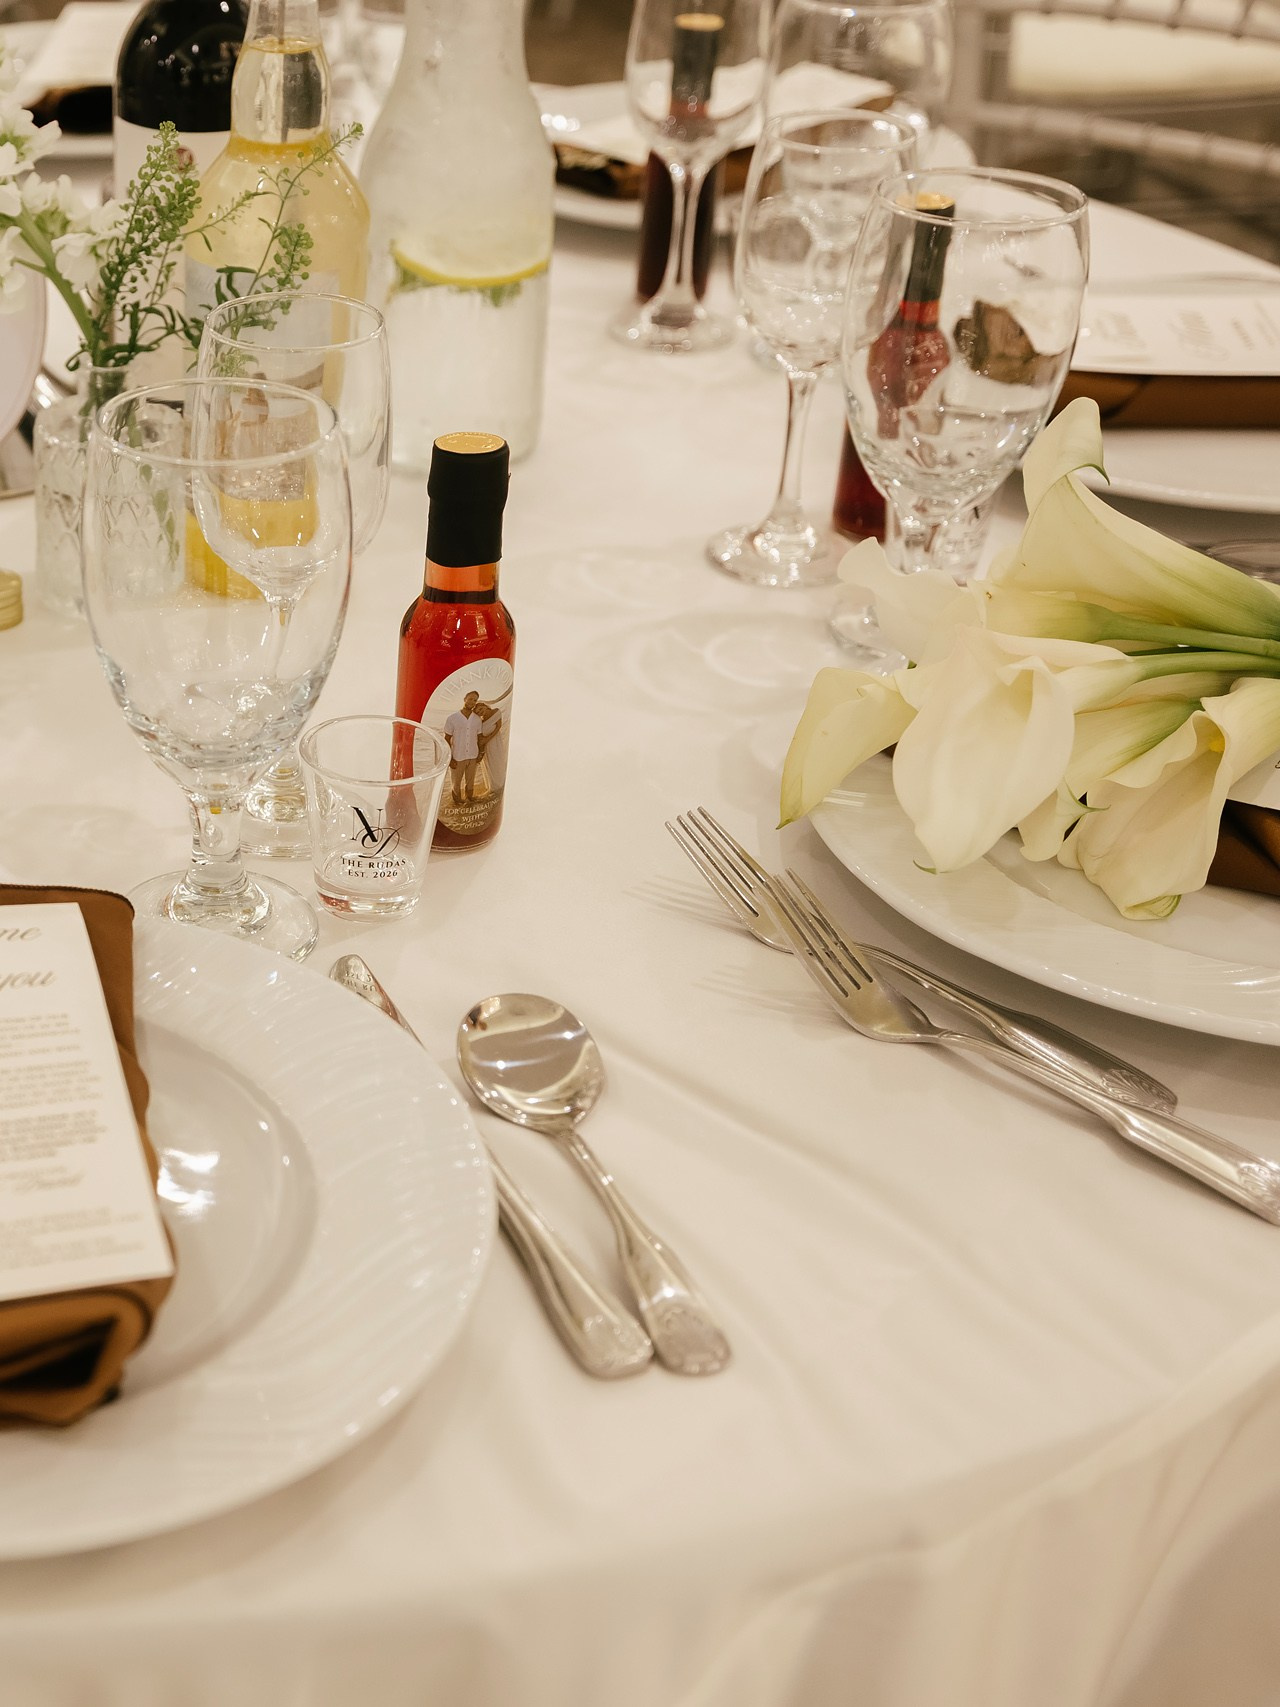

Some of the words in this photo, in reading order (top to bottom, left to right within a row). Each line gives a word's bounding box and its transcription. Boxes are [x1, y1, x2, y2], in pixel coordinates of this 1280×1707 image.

[440, 664, 493, 702] THANK
[444, 807, 459, 815] FOR
[341, 857, 363, 868] THE
[368, 858, 406, 869] RUDAS
[373, 869, 398, 879] 2026
